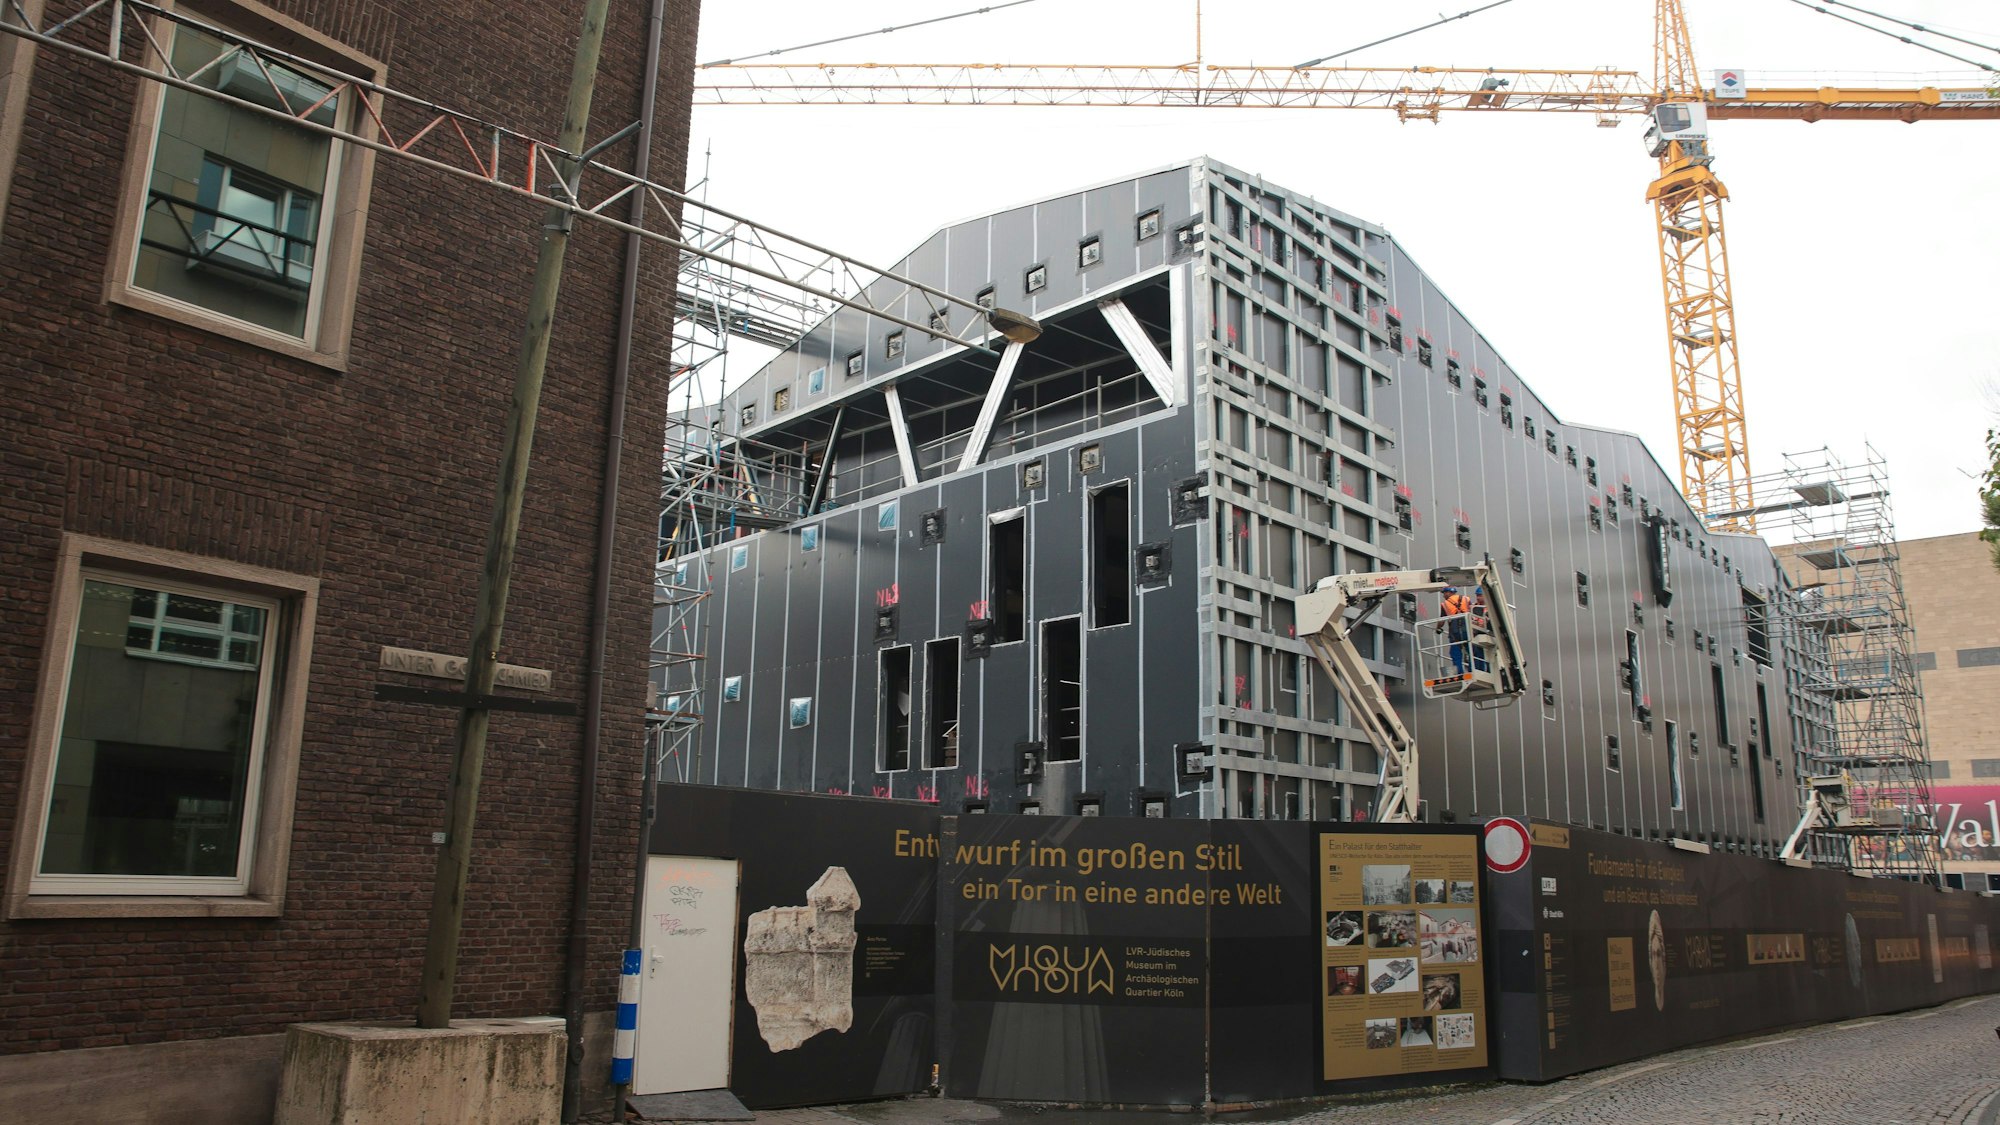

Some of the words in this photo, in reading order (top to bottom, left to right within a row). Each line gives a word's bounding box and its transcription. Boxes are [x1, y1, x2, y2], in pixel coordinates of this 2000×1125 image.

[1375, 576, 1399, 587] mateco
[383, 650, 436, 674] UNTER
[491, 652, 496, 660] 2
[1328, 839, 1342, 850] Ein
[1343, 842, 1364, 850] Palast
[1364, 842, 1374, 850] für
[1375, 842, 1388, 850] den
[1030, 840, 1067, 867] im
[1077, 842, 1185, 875] großen
[1195, 843, 1242, 872] Stil
[1588, 852, 1635, 878] Fundamente
[962, 877, 998, 900] ein
[1007, 878, 1047, 901] Tor
[1055, 880, 1077, 902] in
[1084, 881, 1137, 904] eine
[1144, 884, 1231, 905] andere
[1236, 883, 1282, 906] Welt
[1126, 946, 1191, 958] LVR-Jüdisches
[1125, 960, 1164, 971] Museum
[1165, 961, 1177, 971] im
[1125, 974, 1199, 986] Archäologischen
[1125, 987, 1162, 998] Quartier
[1163, 988, 1185, 998] Köln
